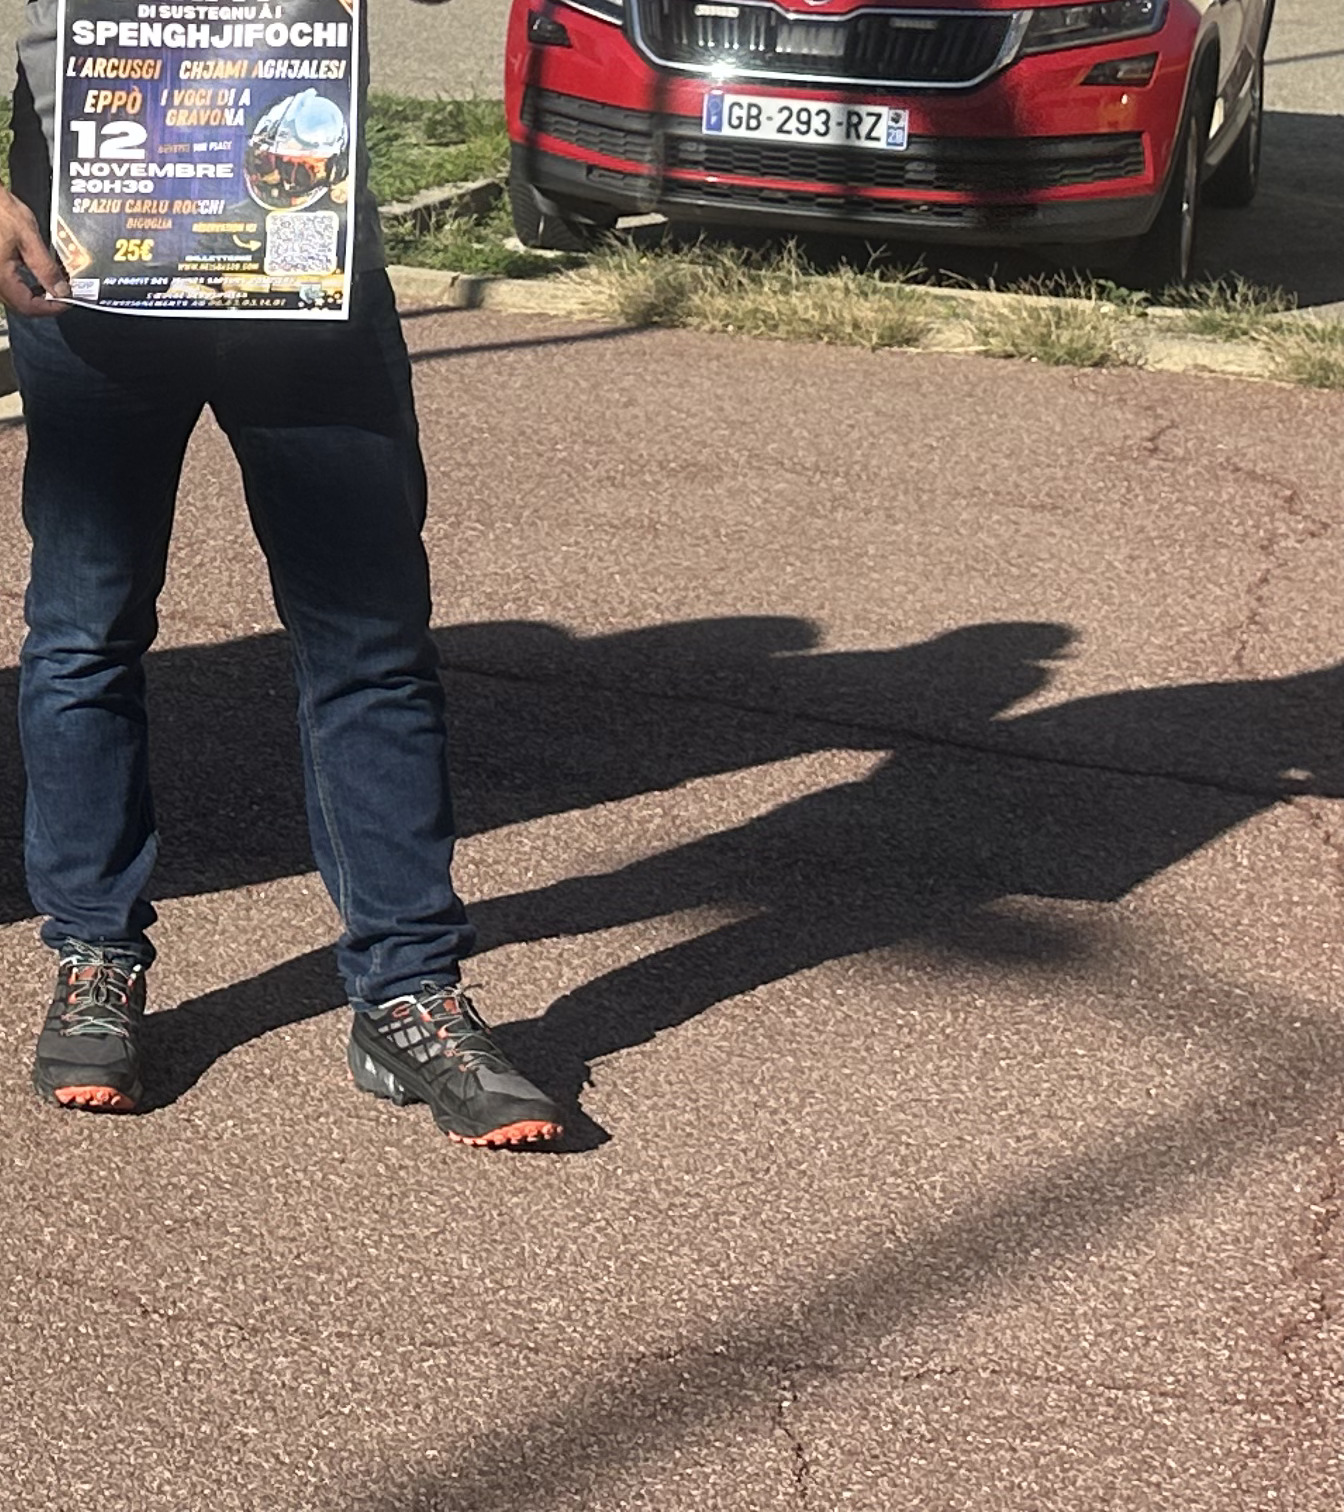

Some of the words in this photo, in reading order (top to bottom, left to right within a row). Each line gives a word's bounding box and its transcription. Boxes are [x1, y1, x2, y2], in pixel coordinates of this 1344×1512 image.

[138, 5, 155, 19] DI
[159, 5, 255, 20] SUSTEGNU
[275, 6, 282, 19] I
[71, 20, 349, 48] SPENGHJIFOCHI
[66, 56, 162, 80] L'ARCUSGI
[179, 59, 247, 80] CHJAMI
[252, 59, 346, 80] AGHJALESI
[83, 85, 143, 115] EPPÒ
[160, 88, 167, 106] I
[173, 88, 212, 106] VOCI
[217, 88, 235, 107] DI
[238, 88, 251, 106] A
[165, 108, 245, 127] GRAVONA
[727, 101, 883, 142] GB-293-RZ
[69, 120, 148, 160] 12
[69, 161, 234, 179] NOVEMBRE
[70, 178, 155, 194] 20H30
[72, 197, 122, 214] SPAZIU
[125, 198, 170, 215] CARLU
[172, 199, 225, 215] ROCCHI
[113, 237, 155, 262] 25€
